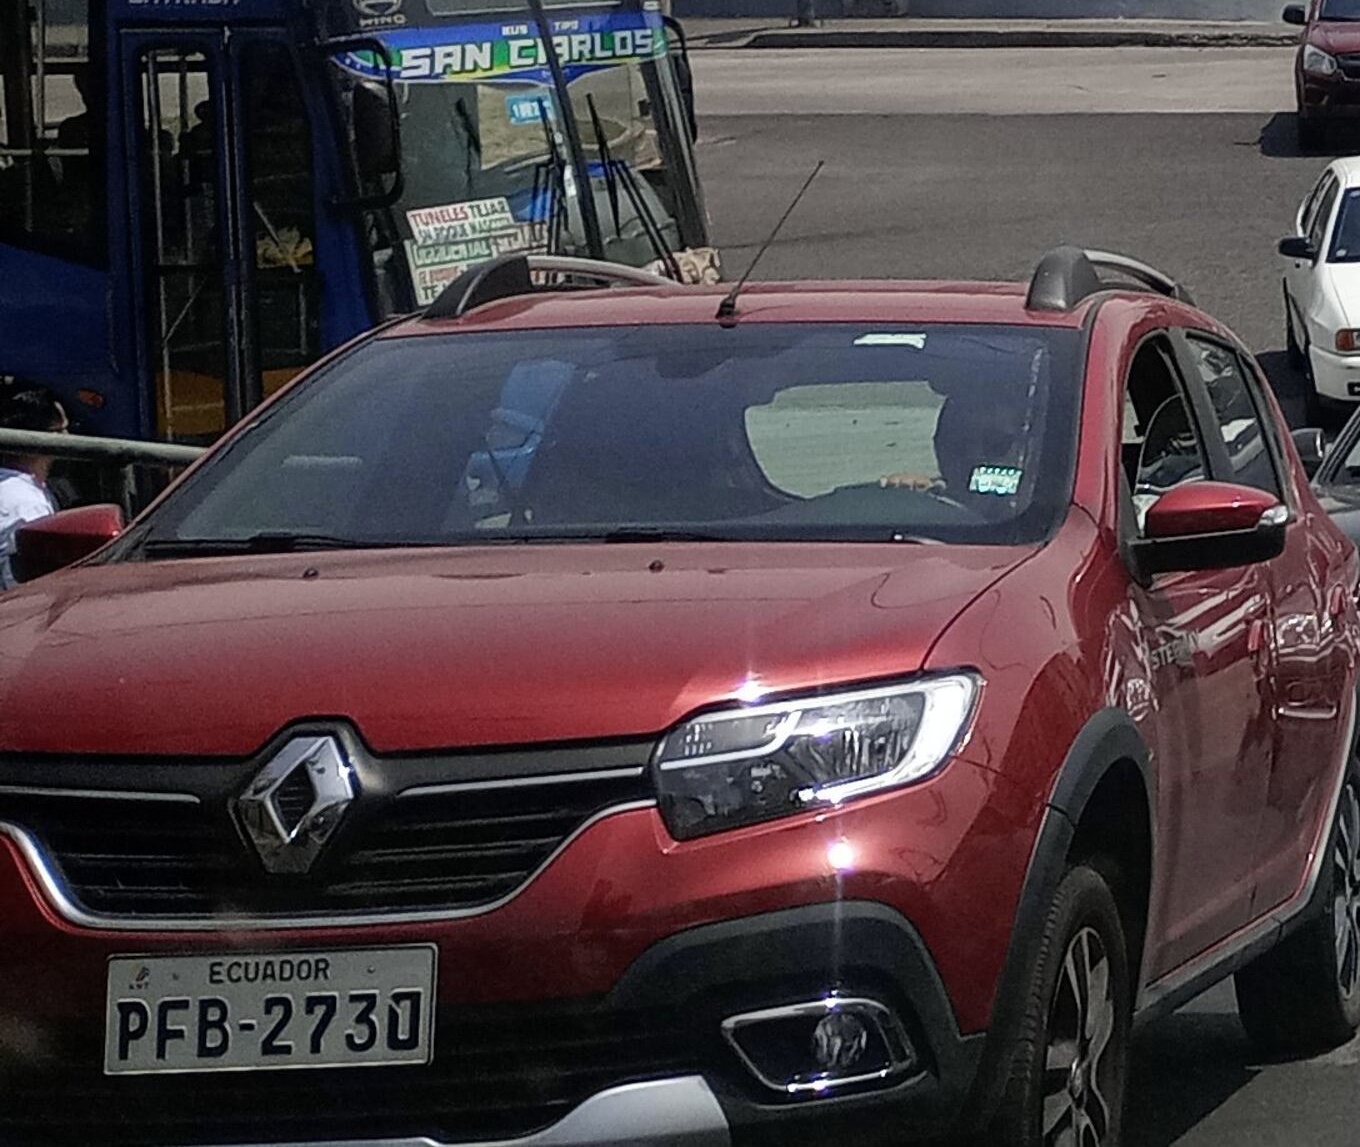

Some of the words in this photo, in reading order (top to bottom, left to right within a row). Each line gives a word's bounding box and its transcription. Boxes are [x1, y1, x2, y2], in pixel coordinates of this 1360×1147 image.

[401, 41, 492, 79] SAN
[508, 28, 654, 69] CARLOS
[208, 958, 330, 984] ECUADOR
[116, 988, 423, 1062] PFB-2730
